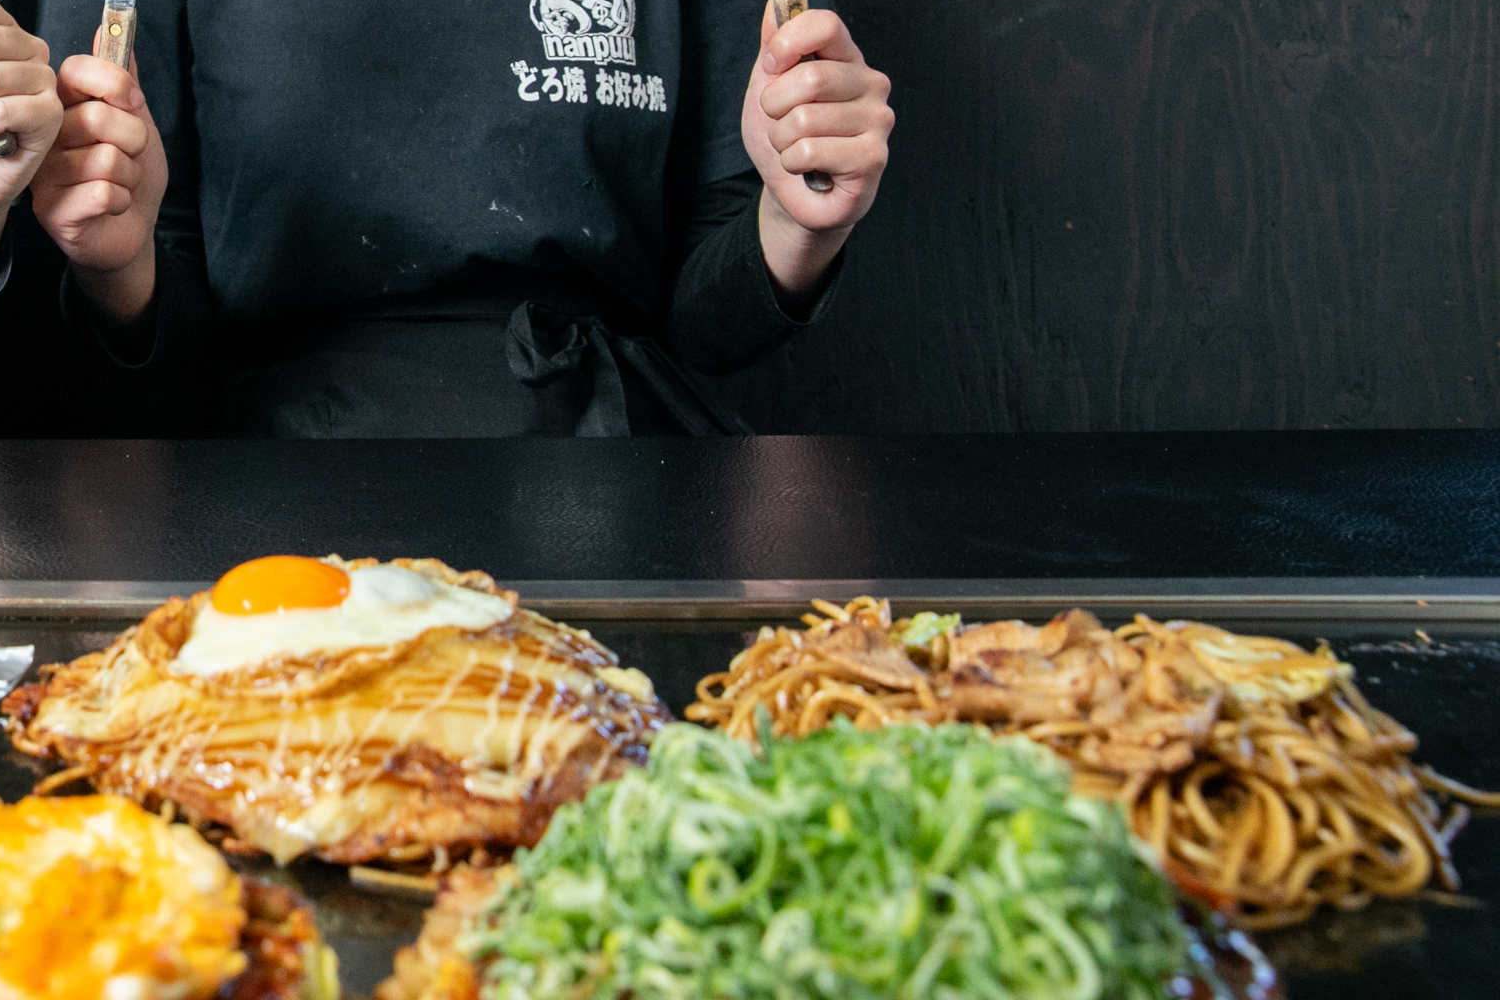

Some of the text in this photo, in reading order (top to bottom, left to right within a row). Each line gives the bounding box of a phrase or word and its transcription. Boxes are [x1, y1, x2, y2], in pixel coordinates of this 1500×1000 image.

[544, 34, 636, 63] nanpuu
[595, 68, 667, 112] お好み焼
